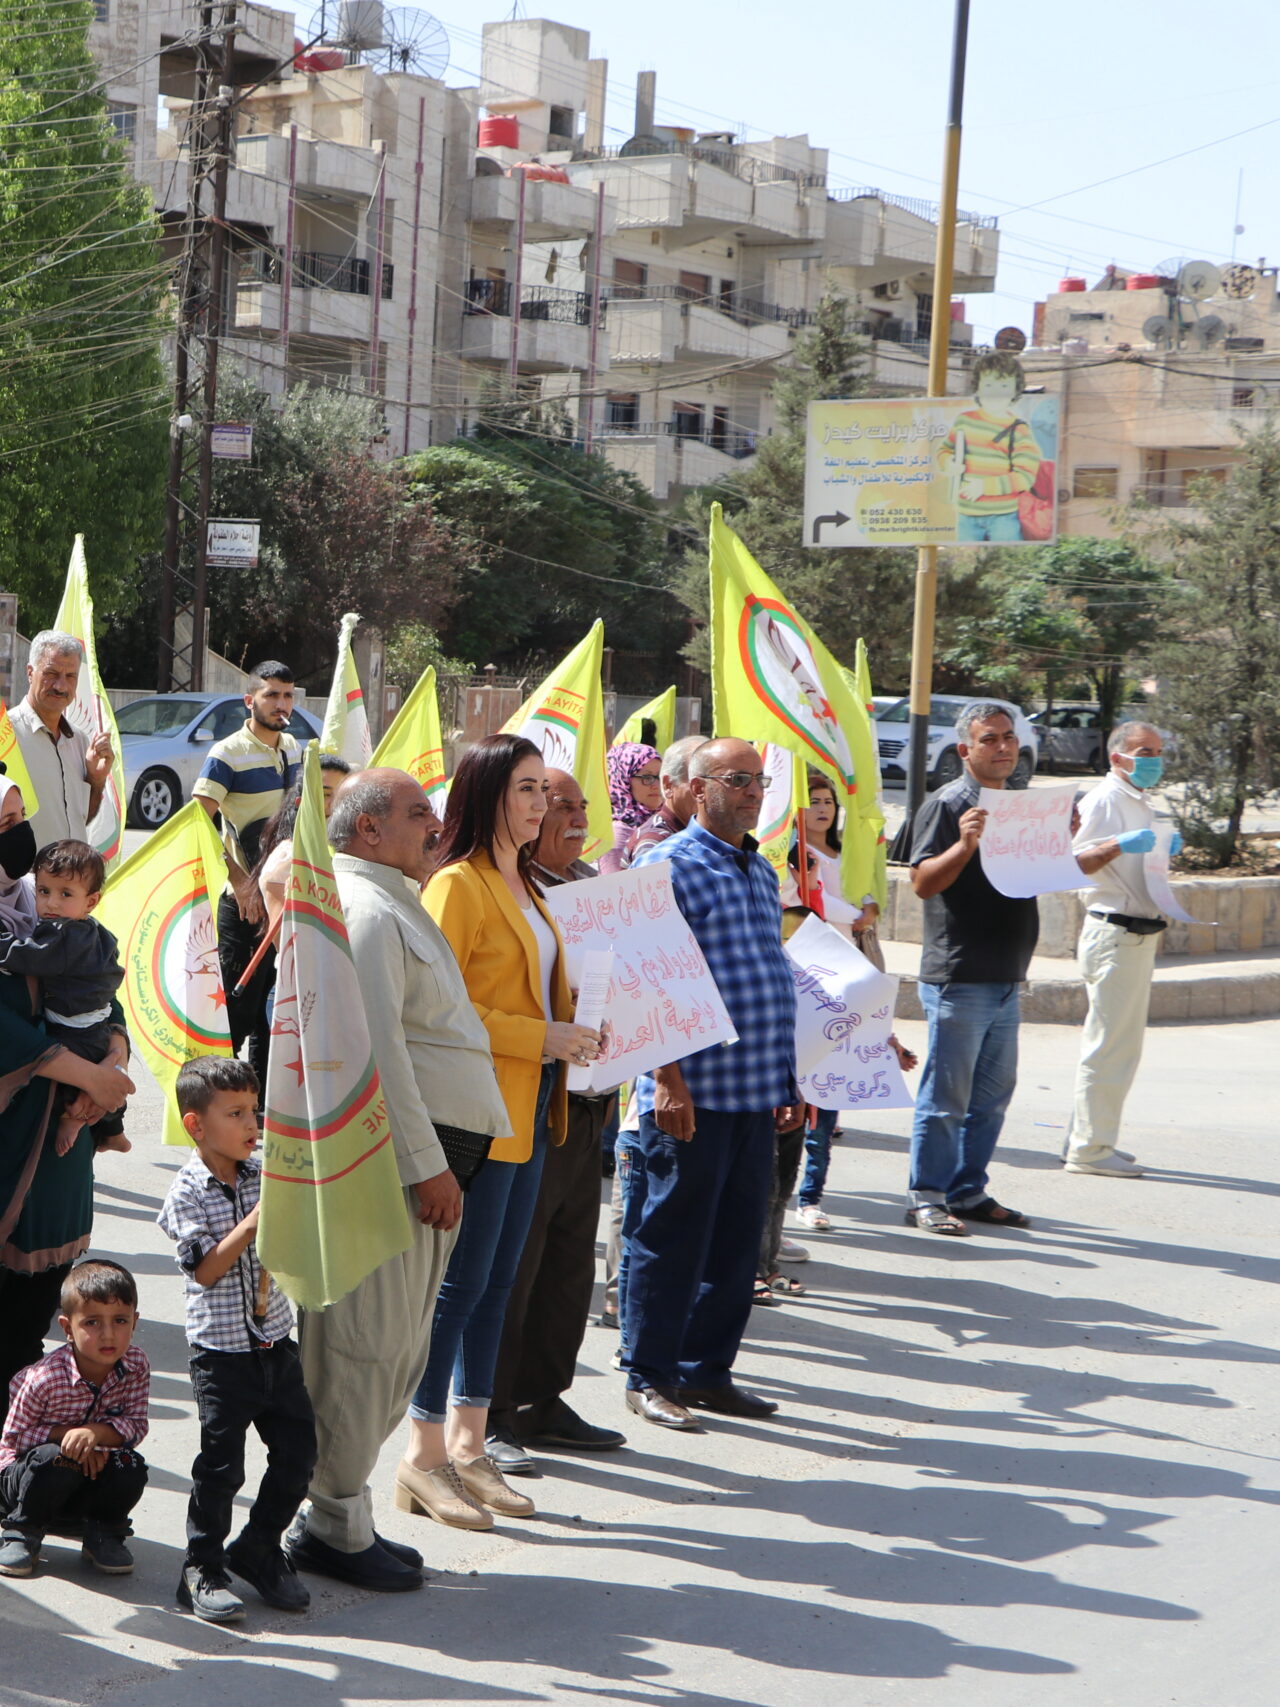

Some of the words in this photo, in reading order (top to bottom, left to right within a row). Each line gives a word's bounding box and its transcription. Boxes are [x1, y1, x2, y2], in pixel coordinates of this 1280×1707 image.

[823, 421, 862, 445] كيدز
[865, 422, 911, 443] برايت
[912, 419, 947, 443] مركز
[888, 508, 904, 516] 430
